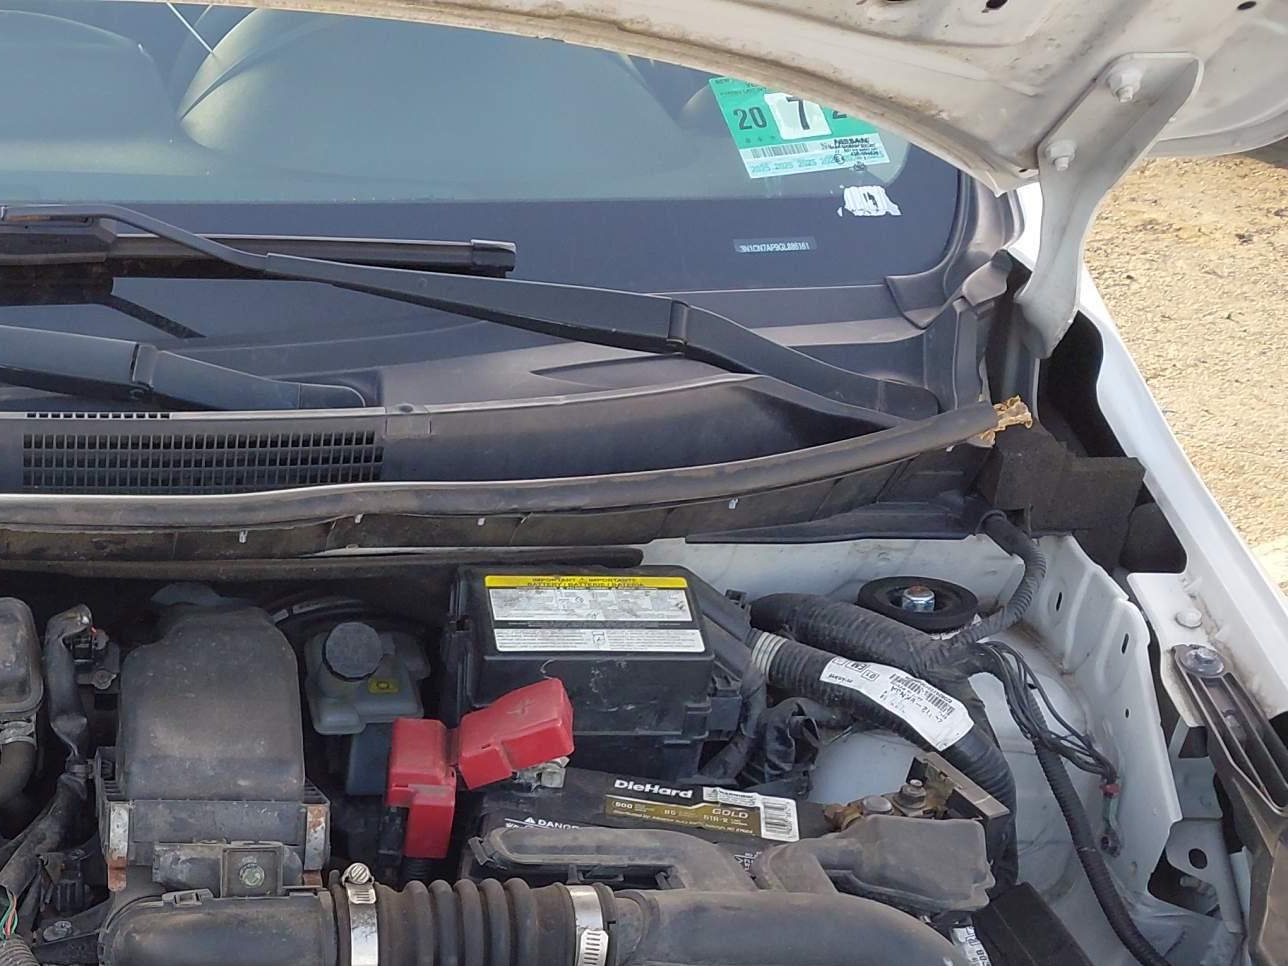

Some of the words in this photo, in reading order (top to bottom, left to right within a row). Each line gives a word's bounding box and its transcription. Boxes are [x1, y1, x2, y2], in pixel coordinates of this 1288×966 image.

[733, 106, 768, 131] 20
[784, 96, 811, 131] 7
[614, 779, 694, 799] DieHard
[712, 808, 749, 819] GOLD
